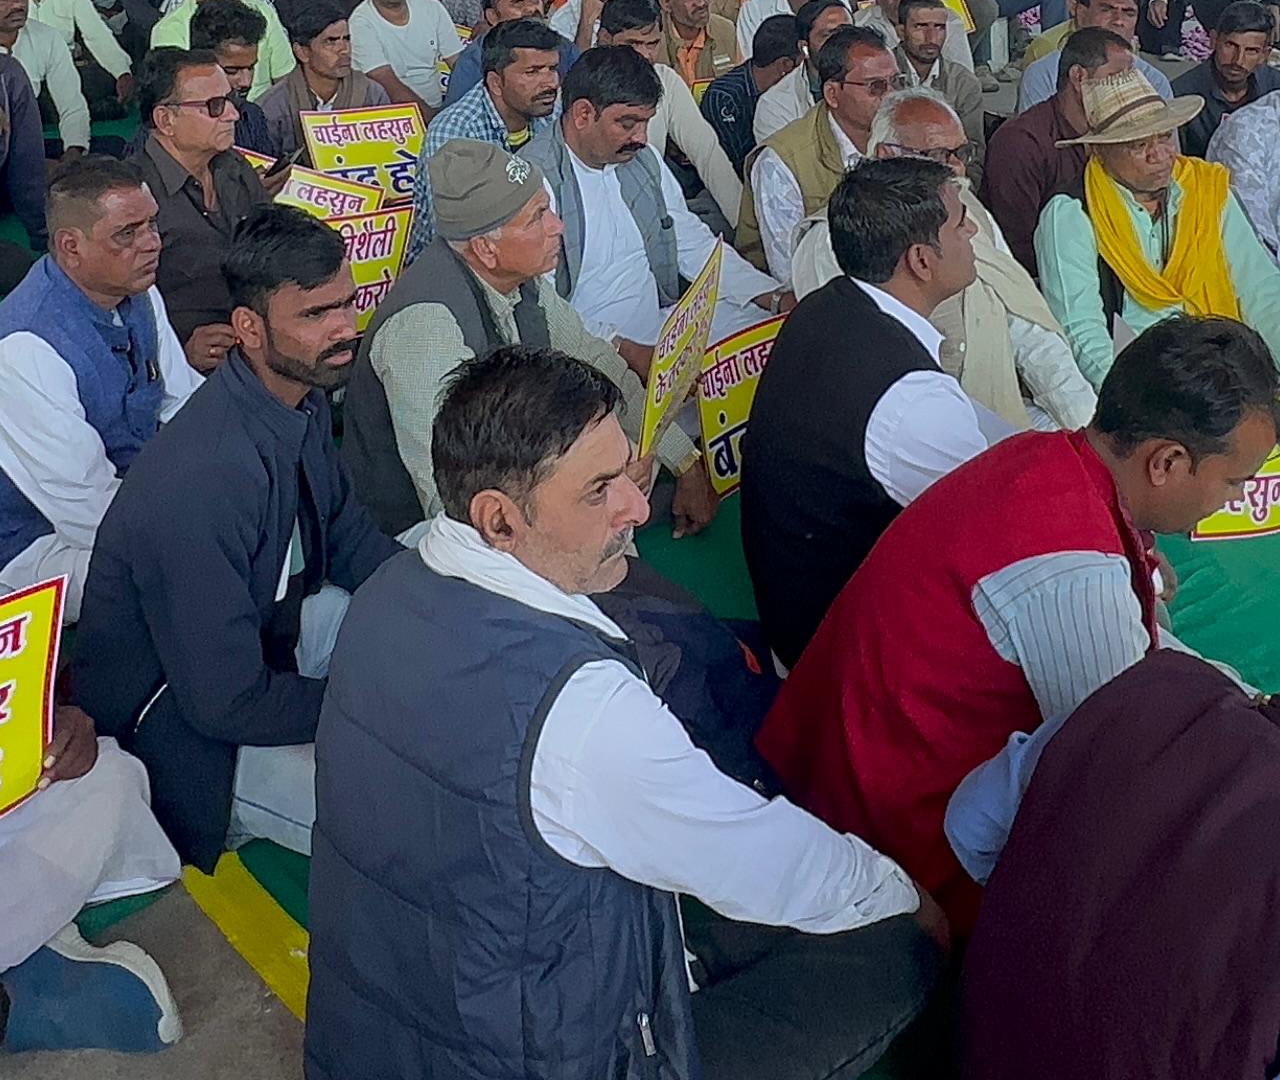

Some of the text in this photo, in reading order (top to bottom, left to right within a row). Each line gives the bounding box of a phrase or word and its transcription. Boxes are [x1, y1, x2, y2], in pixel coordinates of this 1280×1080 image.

[312, 116, 415, 146] चाईना लहसुन
[297, 182, 366, 215] लहसुन
[701, 349, 741, 398] चाईना
